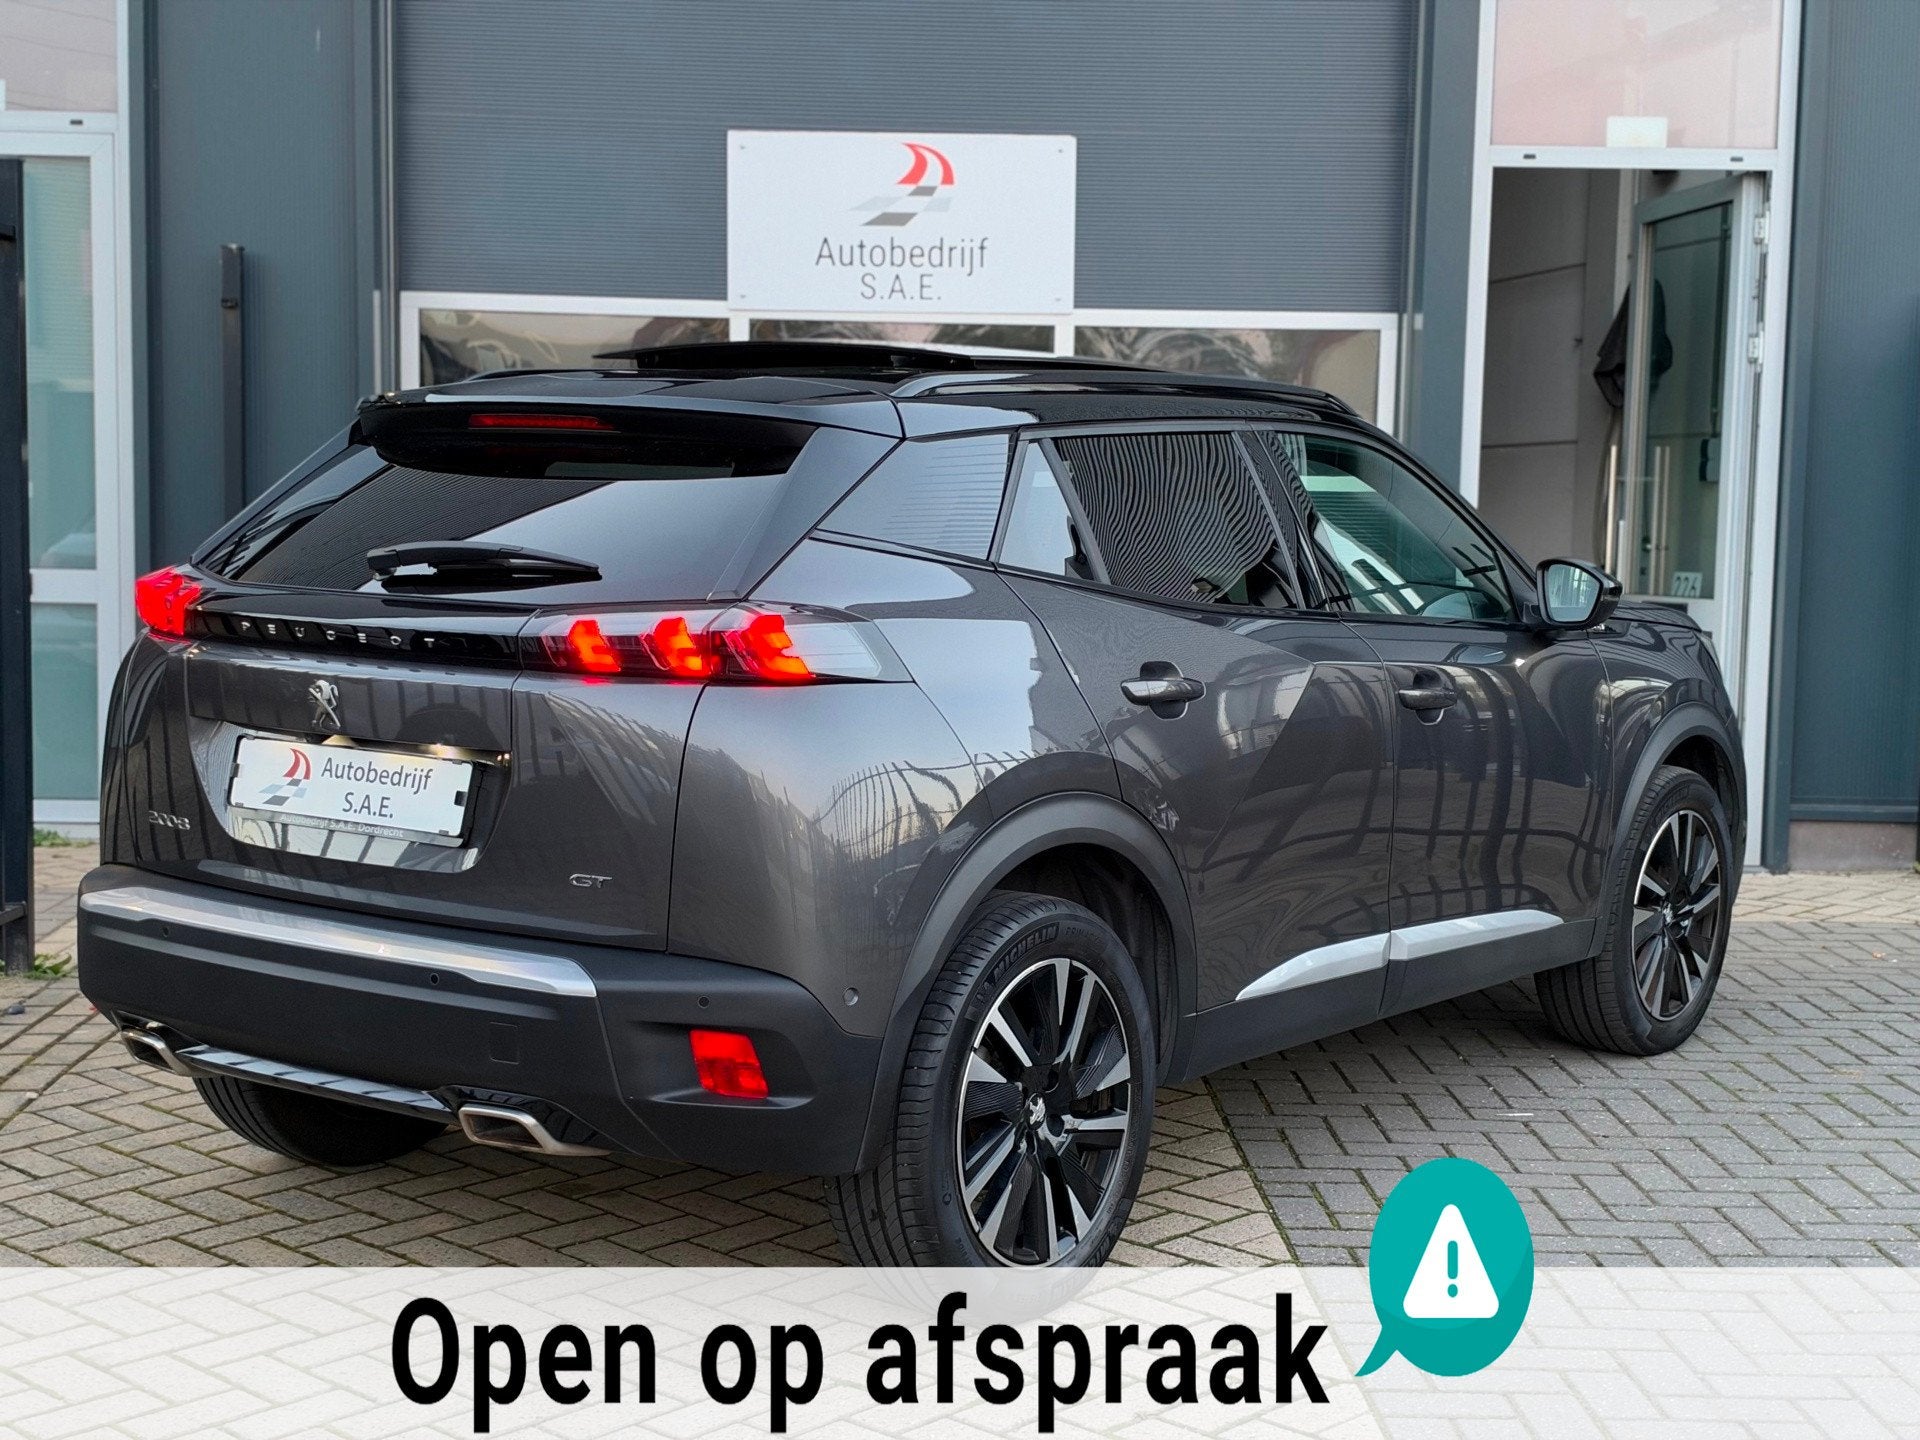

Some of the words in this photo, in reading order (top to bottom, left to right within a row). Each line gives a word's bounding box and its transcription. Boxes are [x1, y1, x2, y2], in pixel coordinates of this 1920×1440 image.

[815, 236, 989, 277] Autobedrijf
[860, 272, 942, 301] S.A.E.
[241, 621, 435, 648] PEUGEOT
[320, 756, 434, 795] Autobedrijf
[147, 809, 191, 831] 2008
[342, 791, 395, 820] S.A.E.
[279, 814, 328, 829] Autobedrijf
[358, 823, 404, 838] Dordrecht
[569, 873, 613, 888] GT
[993, 924, 1058, 983] MICHELIN
